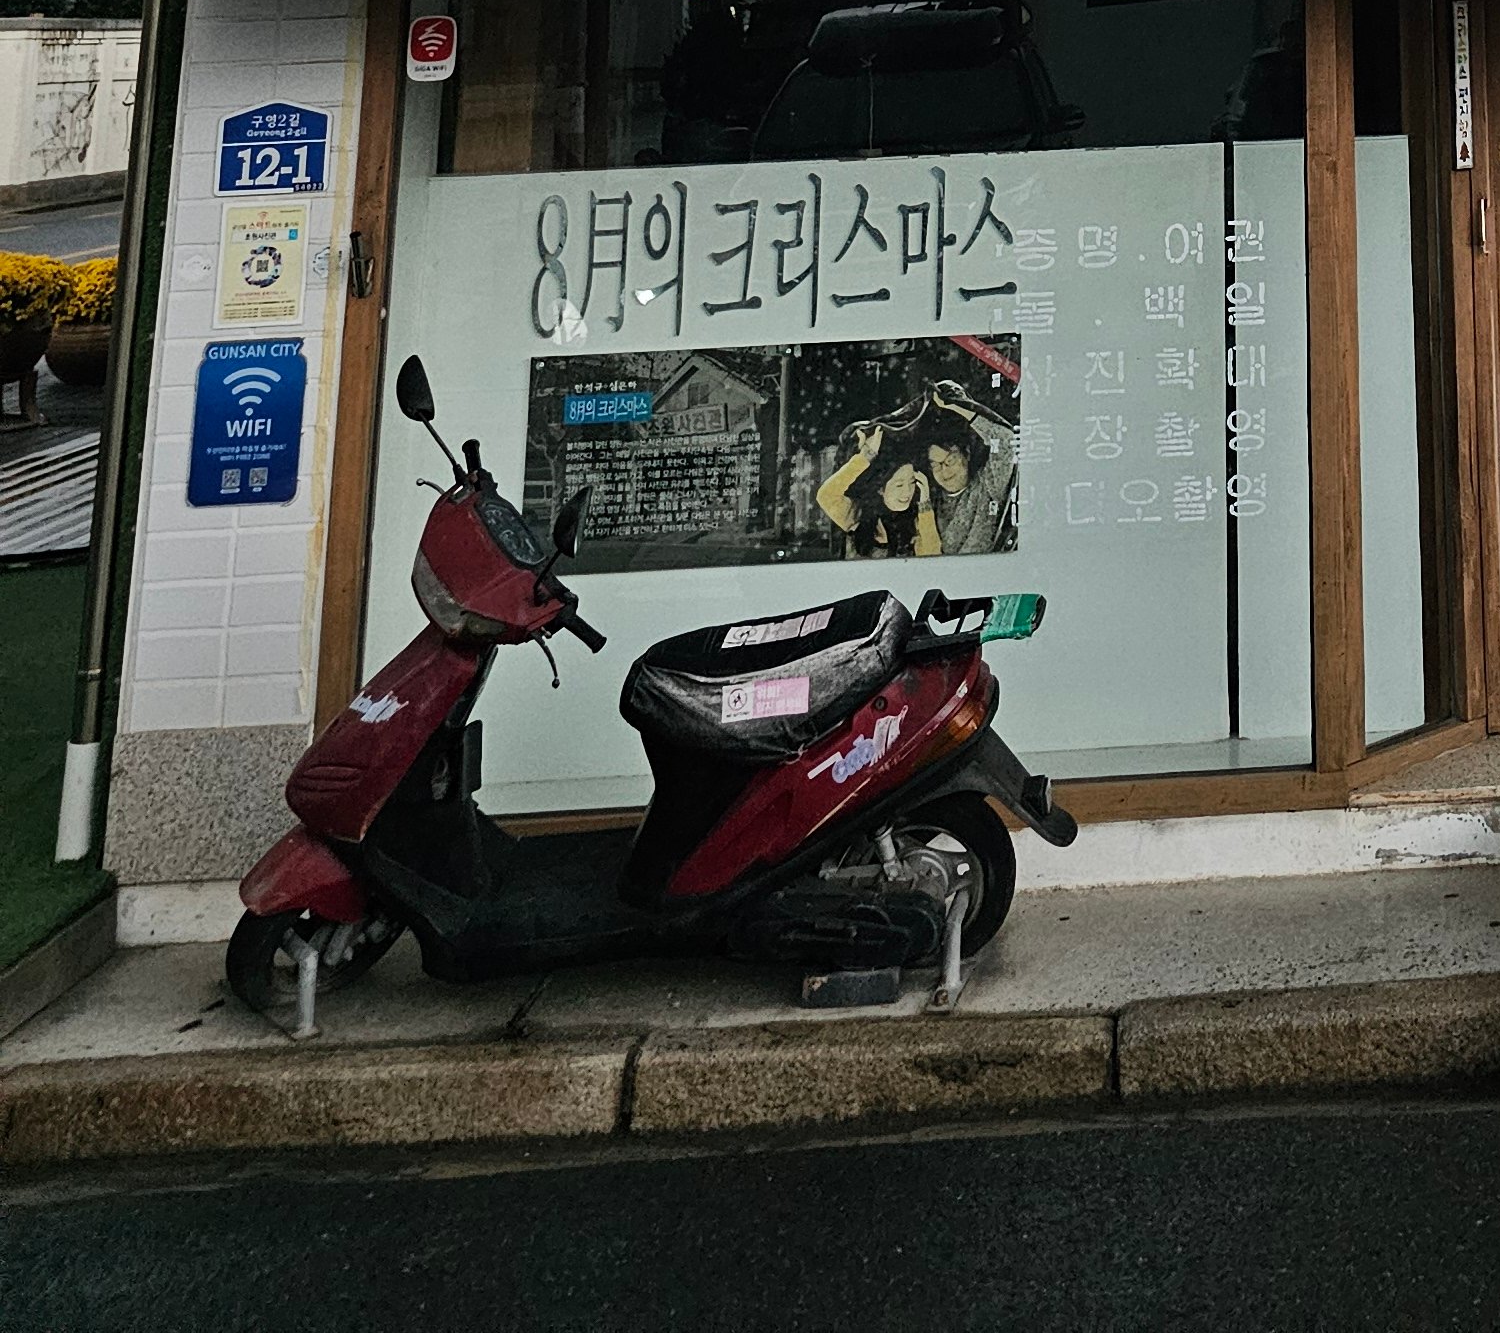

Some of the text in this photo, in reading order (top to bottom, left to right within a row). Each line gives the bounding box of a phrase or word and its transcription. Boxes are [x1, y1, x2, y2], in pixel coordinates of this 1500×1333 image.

[251, 114, 300, 128] 구영2길
[235, 146, 311, 186] 12-1
[531, 165, 1018, 339] 8月의 크리스마스
[208, 343, 301, 360] GUNSAN CITY
[597, 397, 648, 420] 크리스마스
[226, 419, 272, 438] WIFI
